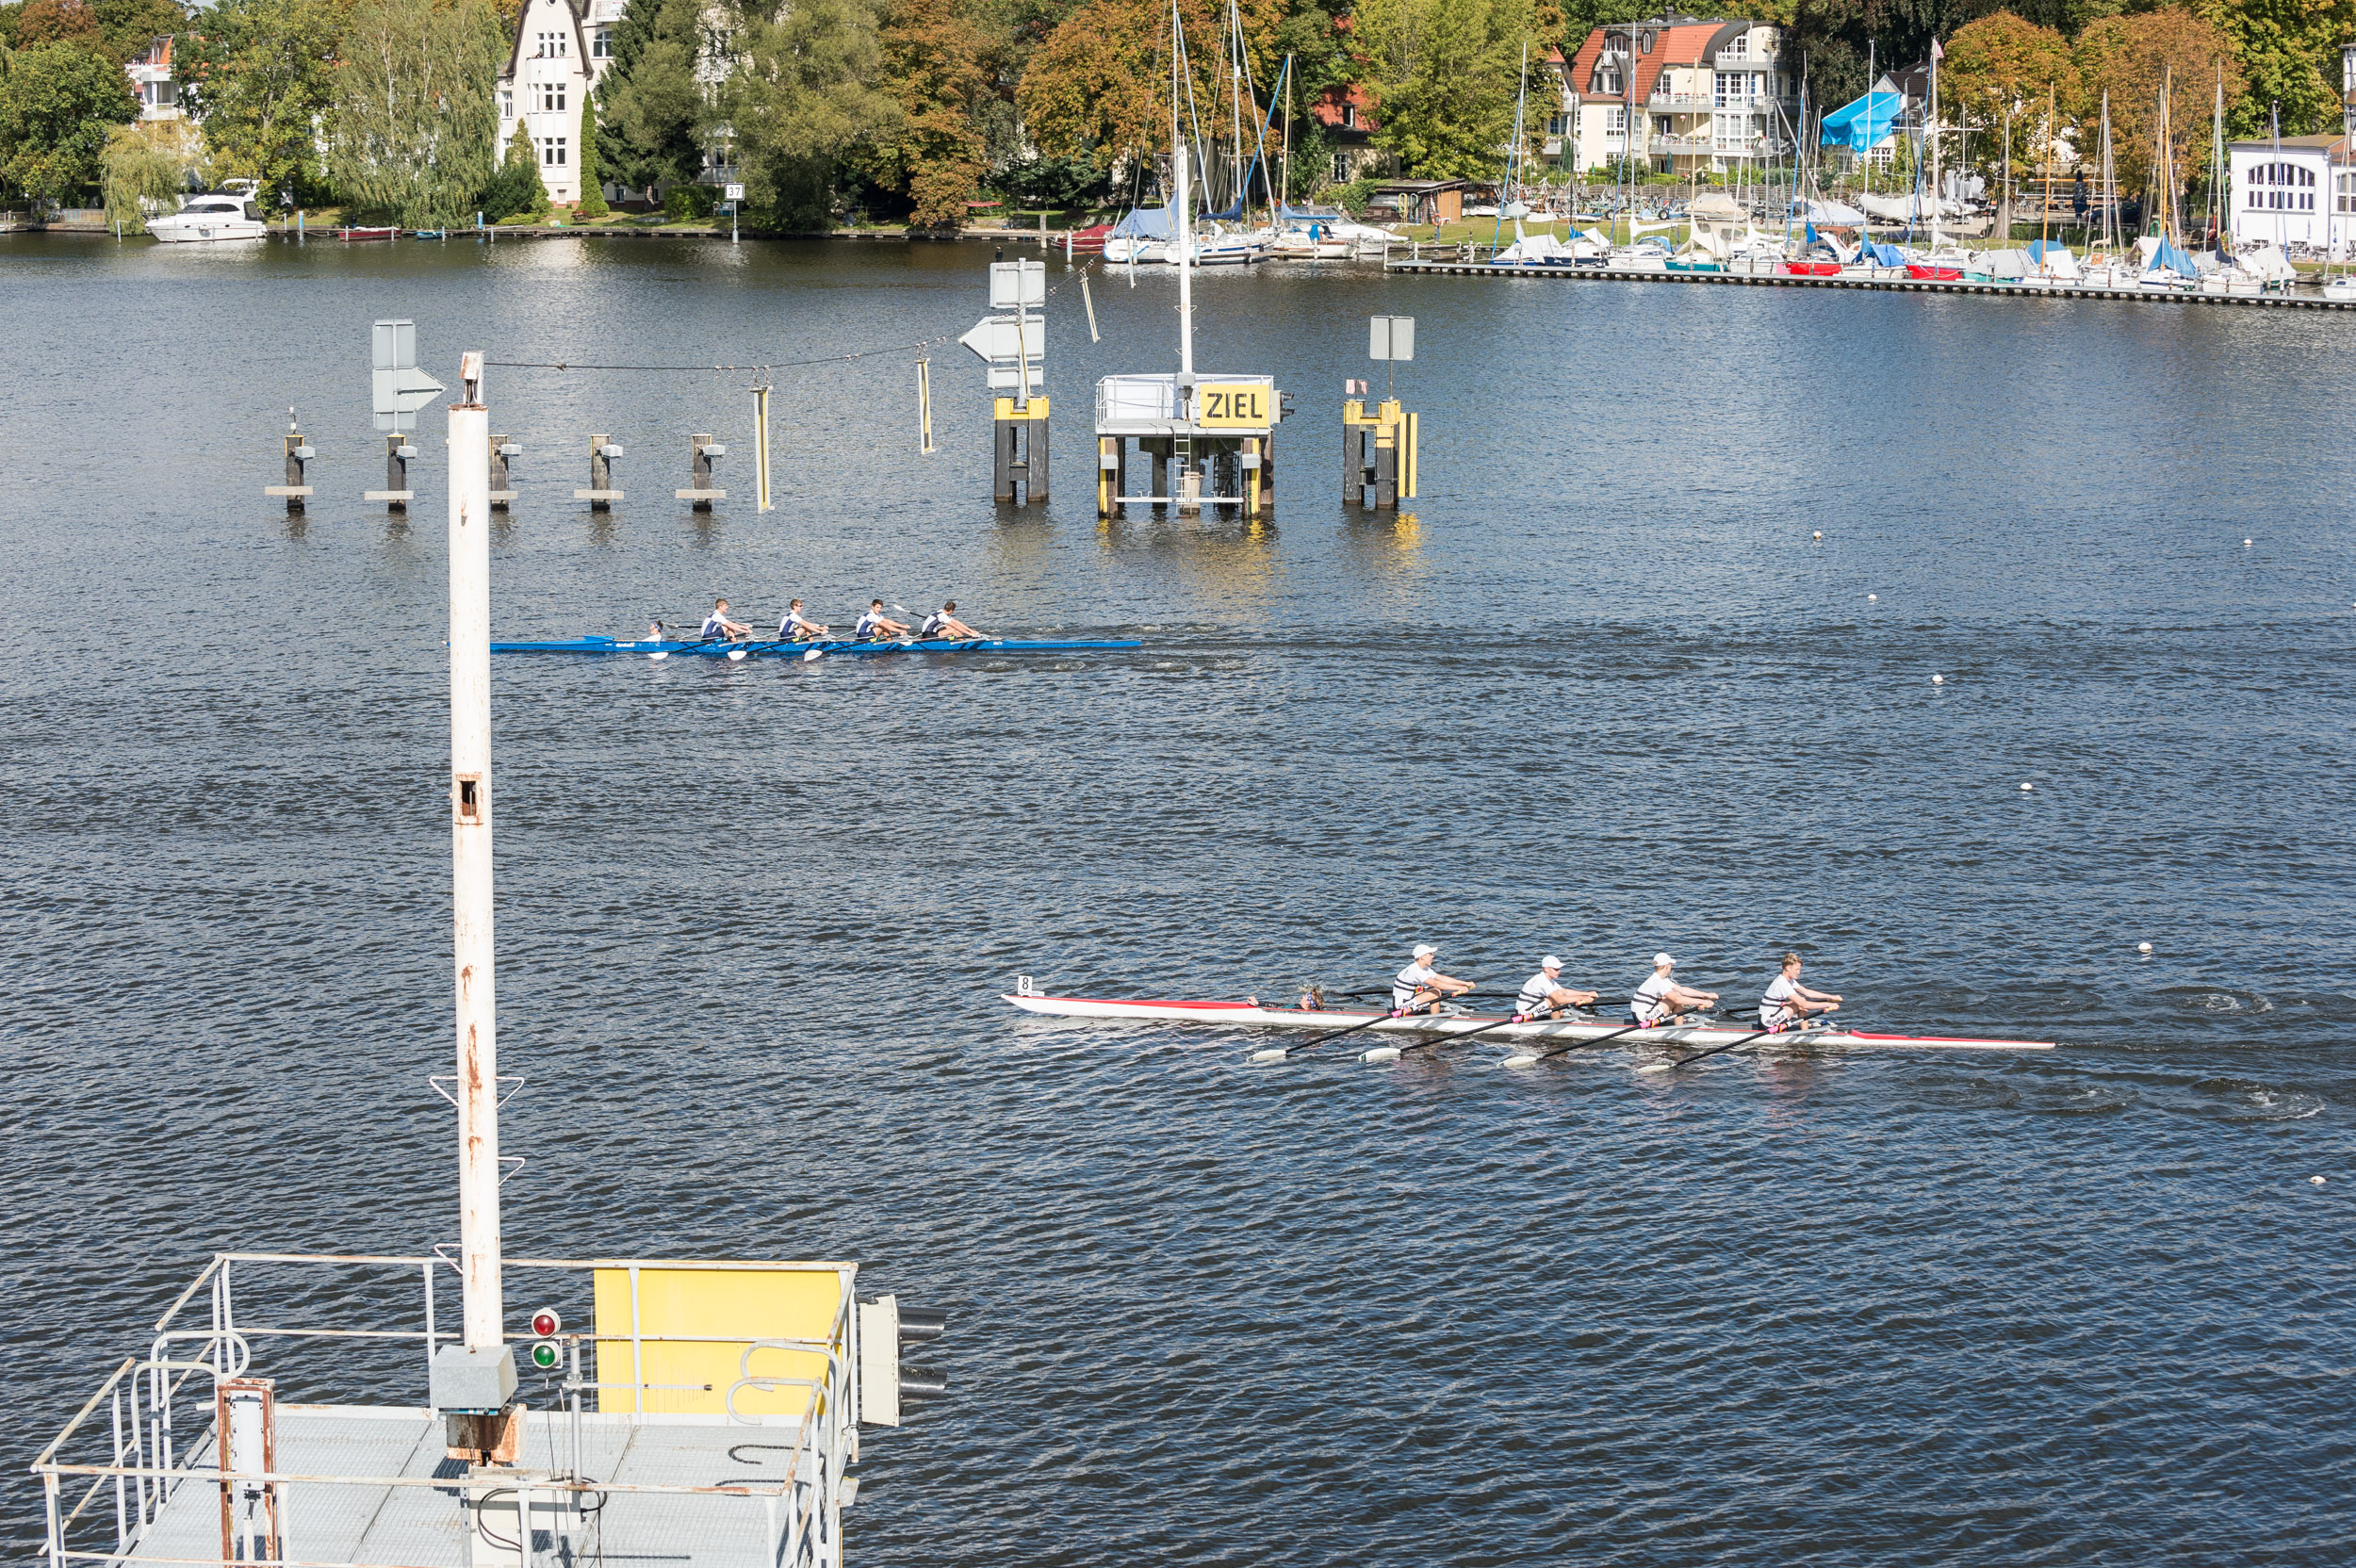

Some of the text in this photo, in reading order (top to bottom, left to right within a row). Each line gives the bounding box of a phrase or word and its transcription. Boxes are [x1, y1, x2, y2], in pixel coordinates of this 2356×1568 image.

[728, 187, 741, 197] 37
[1206, 393, 1263, 418] ZIEL
[1022, 976, 1029, 990] 8
